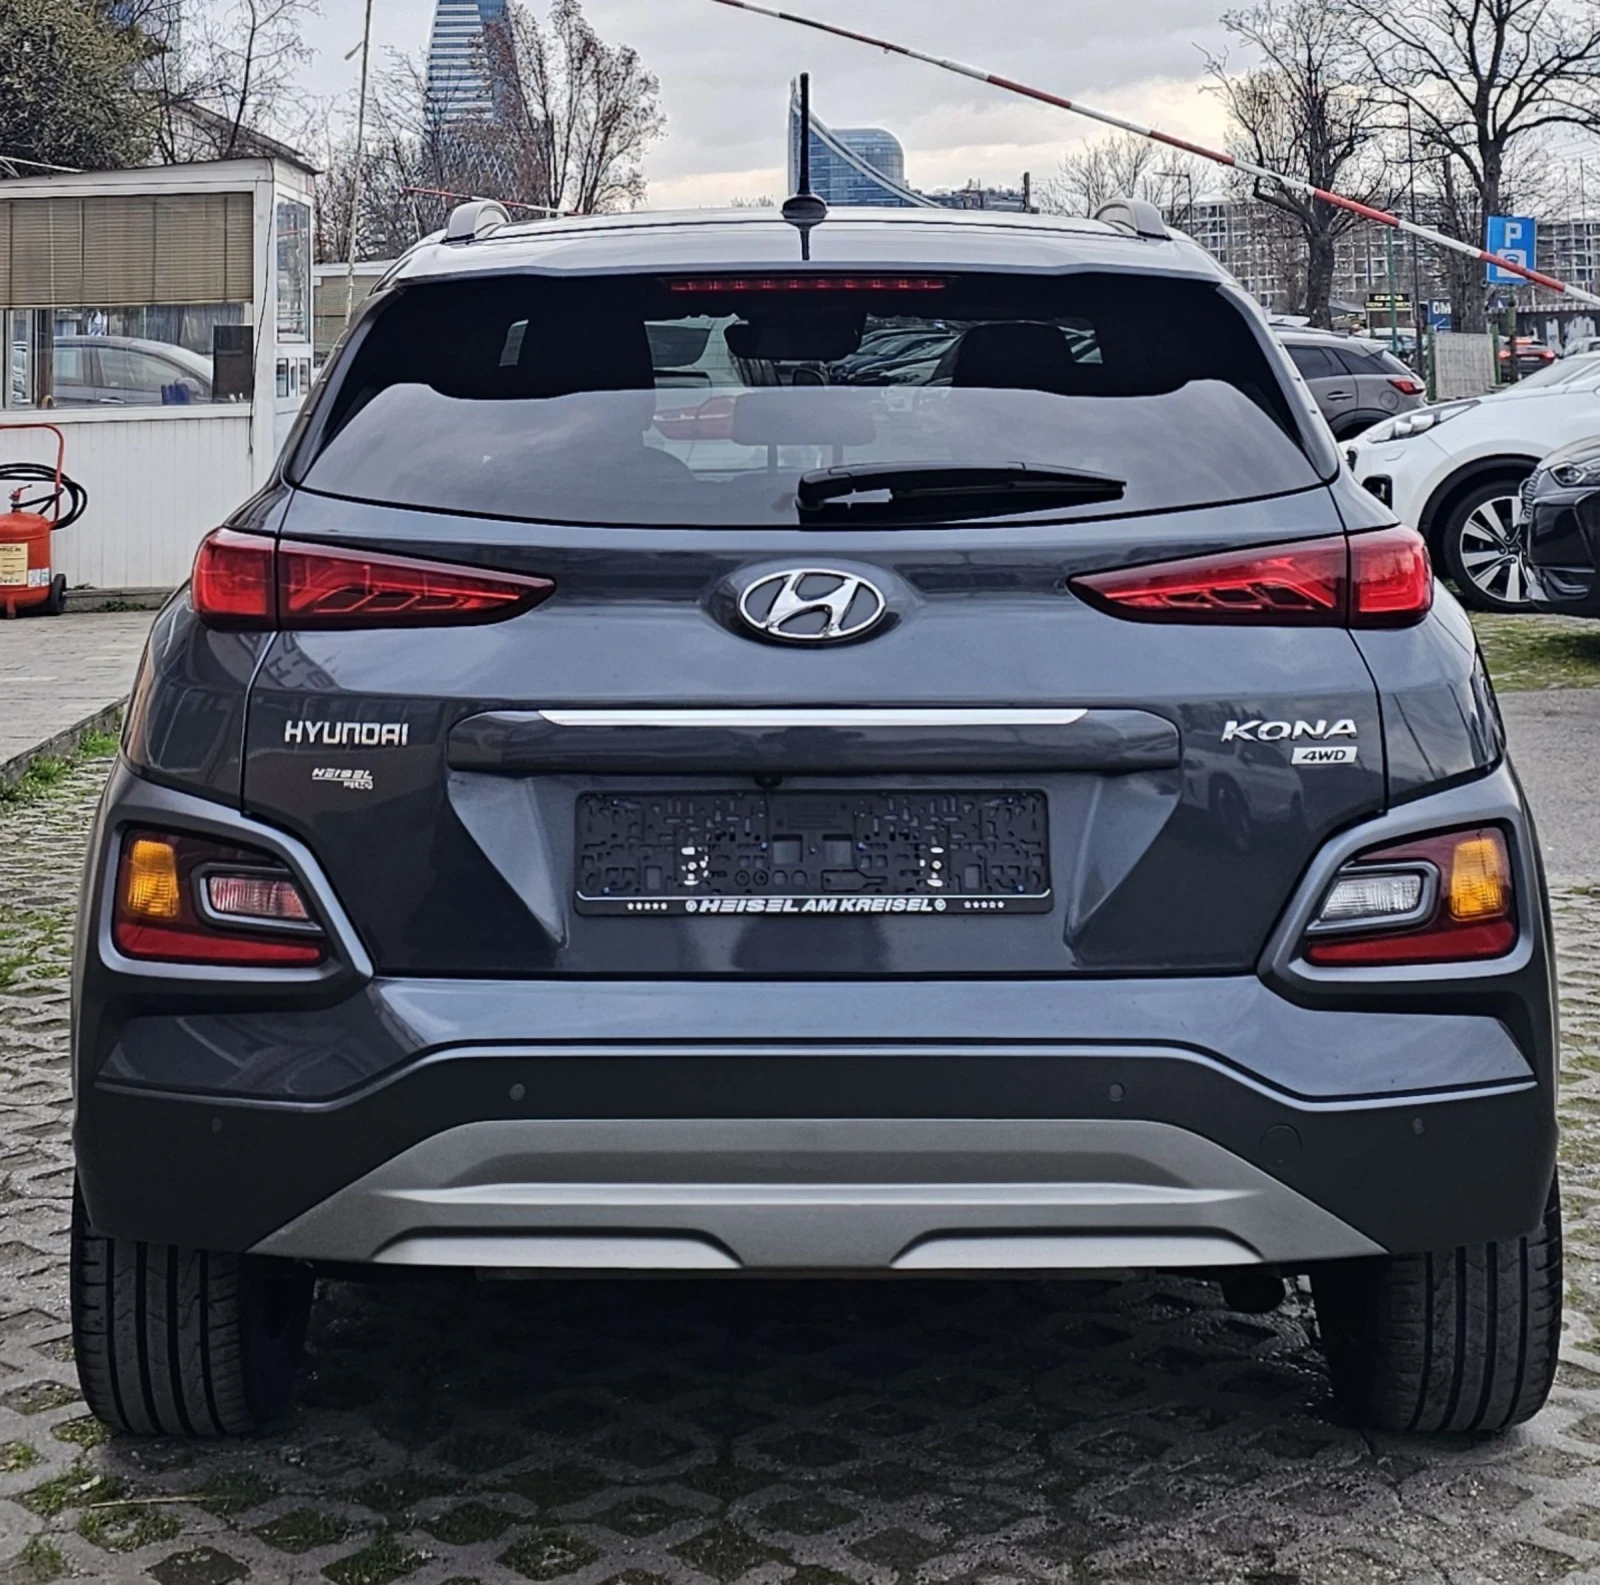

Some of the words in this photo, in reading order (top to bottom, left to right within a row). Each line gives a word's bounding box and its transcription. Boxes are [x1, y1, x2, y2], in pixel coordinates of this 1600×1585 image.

[1505, 223, 1522, 248] P
[284, 720, 409, 746] HYUNDAI
[1220, 718, 1358, 742] KONA
[1302, 750, 1346, 762] 4WD
[699, 899, 799, 913] HEISEL
[801, 899, 838, 912] AM
[839, 898, 933, 912] KREISEL
